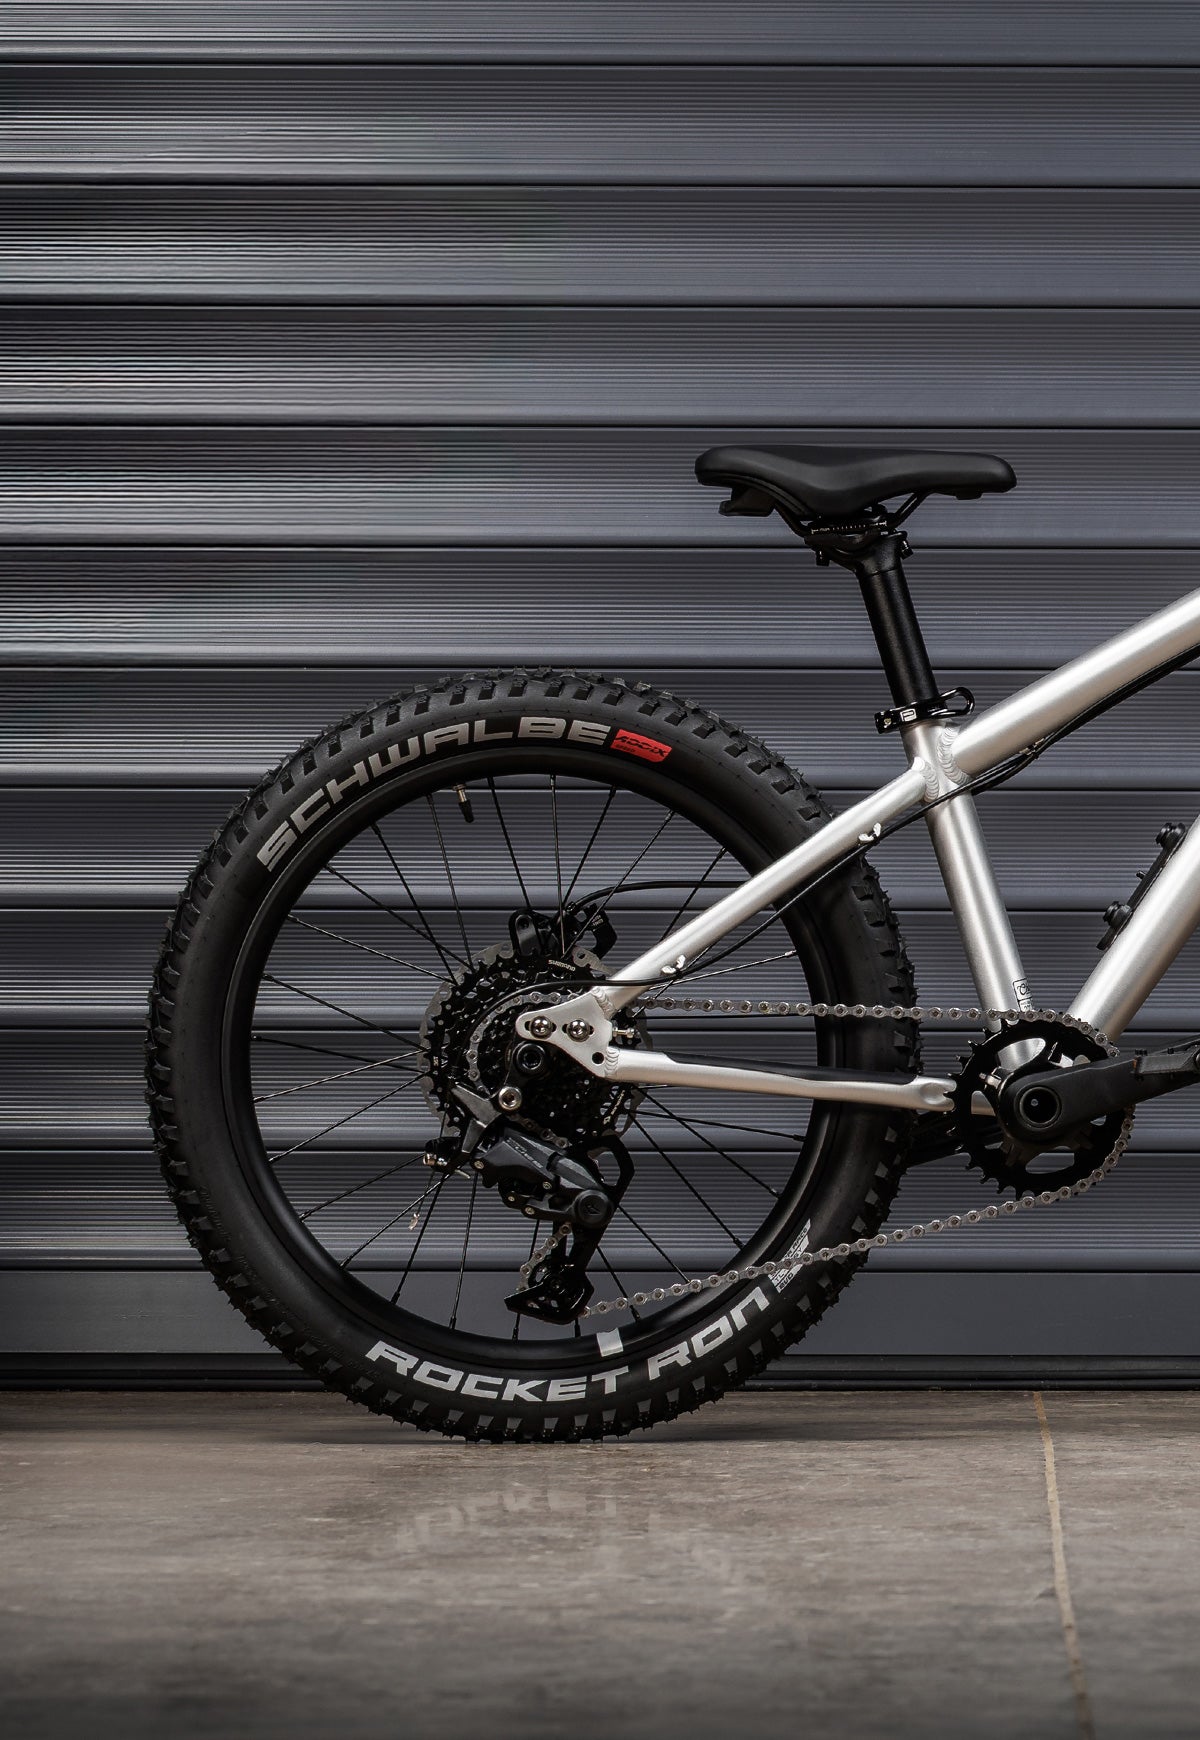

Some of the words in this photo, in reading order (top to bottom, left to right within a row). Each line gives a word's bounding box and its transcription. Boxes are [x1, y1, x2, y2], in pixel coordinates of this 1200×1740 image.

[256, 716, 611, 872] SCHWALBE
[364, 1340, 629, 1402] ROCKET
[648, 1287, 769, 1381] RON
